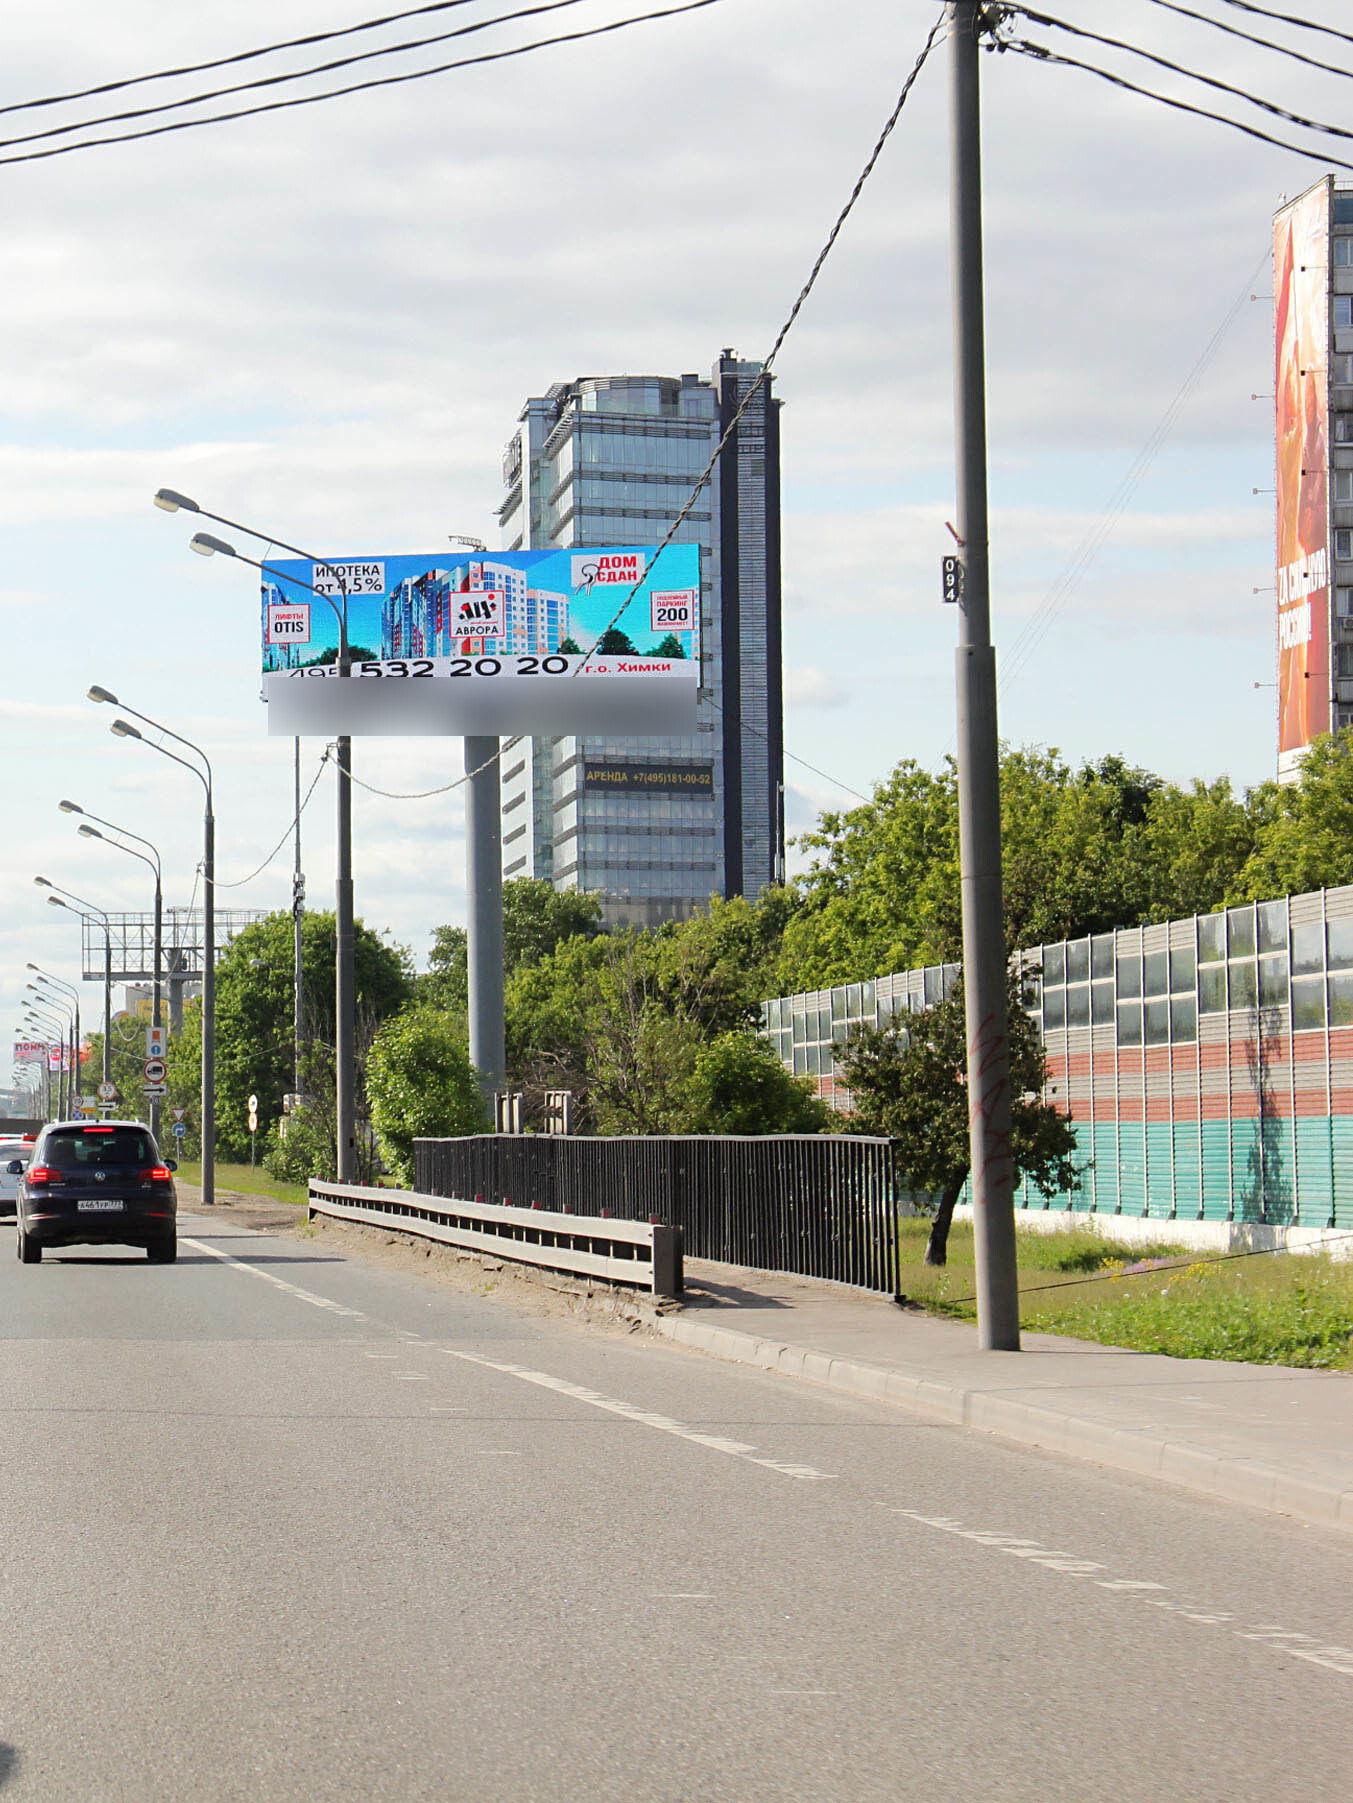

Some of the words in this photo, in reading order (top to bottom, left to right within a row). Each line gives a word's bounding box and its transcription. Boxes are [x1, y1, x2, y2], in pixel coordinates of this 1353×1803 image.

[599, 556, 637, 570] ДОМ
[597, 571, 637, 582] СДАН
[657, 608, 689, 621] 200
[275, 621, 304, 633] OTIS
[455, 626, 499, 636] АВРОРА
[360, 661, 434, 678] 532
[449, 658, 503, 677] 20
[516, 655, 569, 676] 20
[618, 662, 671, 672] Химки
[587, 771, 628, 783] АРЕНДА
